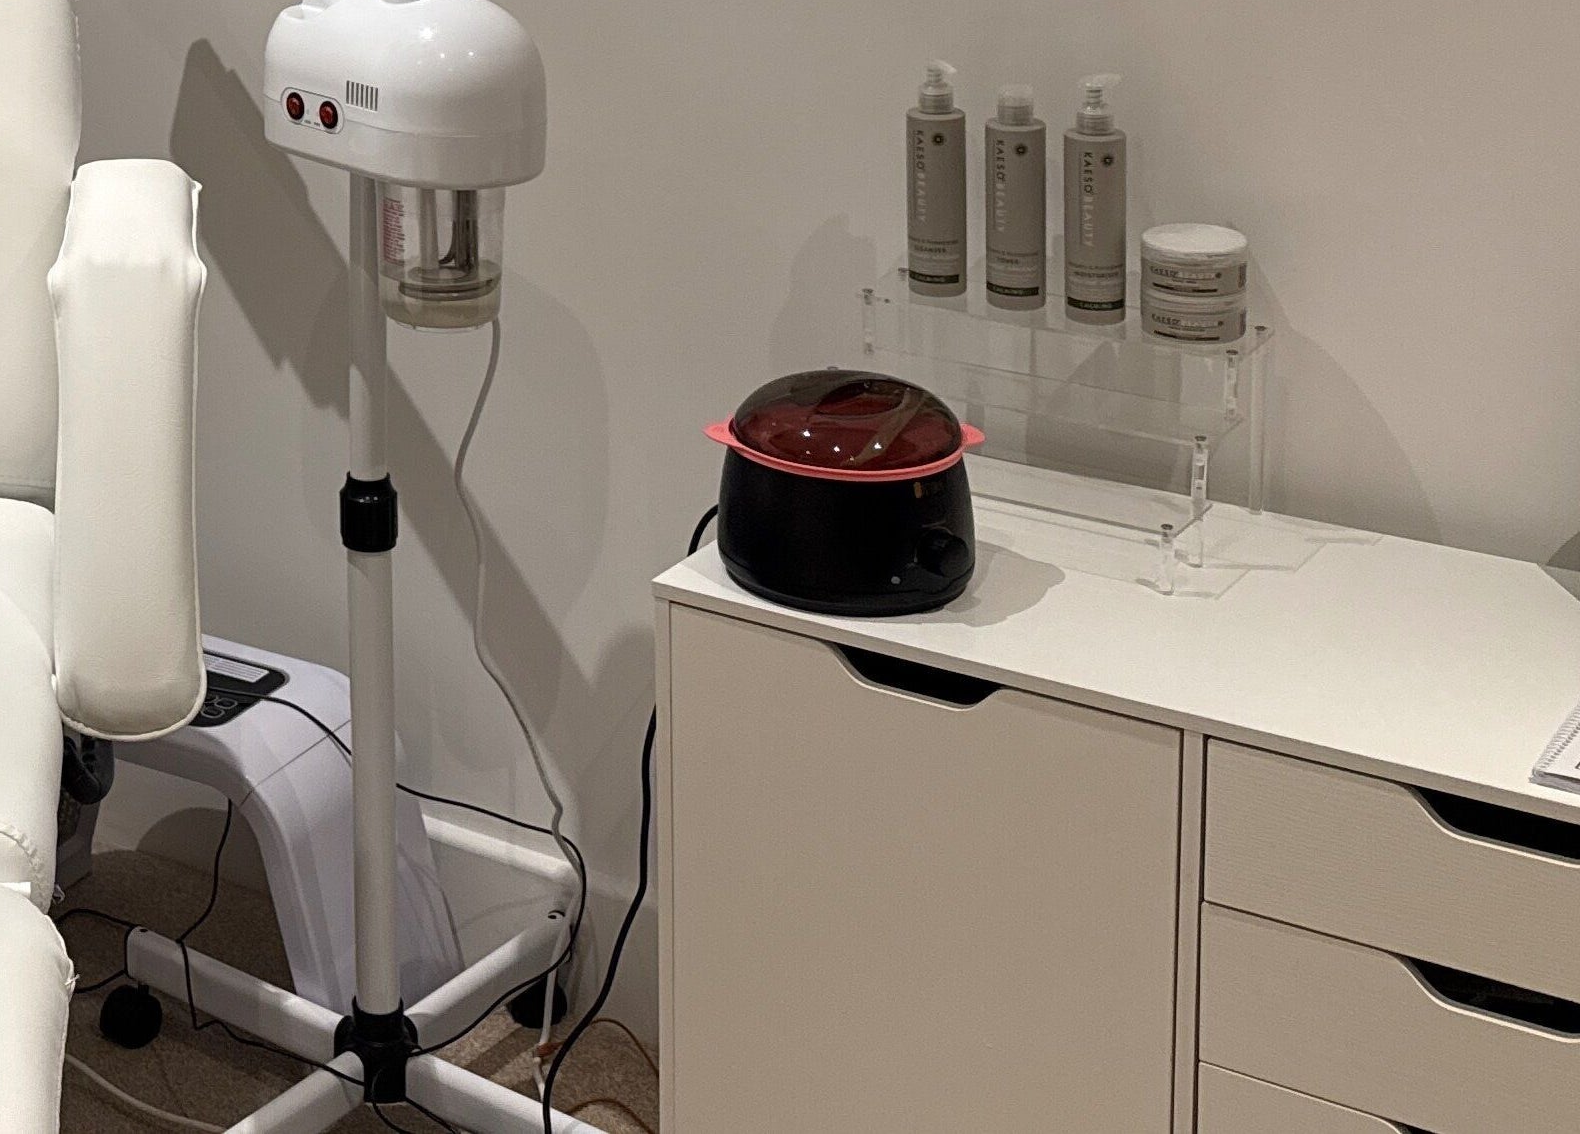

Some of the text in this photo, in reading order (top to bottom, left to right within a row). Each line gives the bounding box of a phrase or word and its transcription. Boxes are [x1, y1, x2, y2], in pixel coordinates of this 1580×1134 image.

[916, 130, 925, 170] KAESO
[996, 139, 1006, 233] KAESO BEAUTY
[1083, 152, 1094, 247] KAESO BEAUTY
